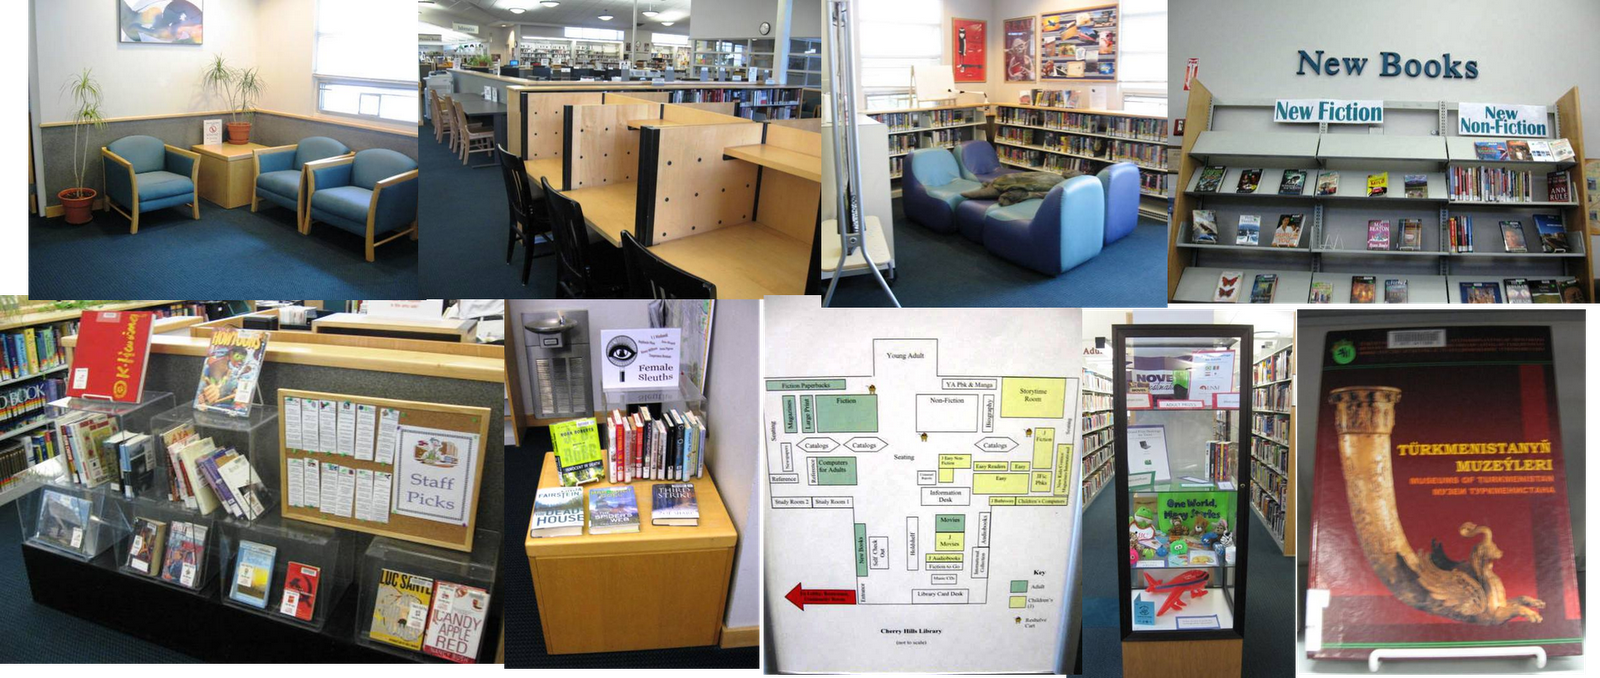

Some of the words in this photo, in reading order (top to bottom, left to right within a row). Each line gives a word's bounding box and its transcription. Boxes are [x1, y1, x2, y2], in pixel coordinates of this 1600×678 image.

[1297, 50, 1368, 76] New
[1379, 52, 1479, 79] Books
[1275, 101, 1314, 121] New
[1318, 101, 1382, 122] Fiction
[1484, 106, 1518, 120] New
[1460, 118, 1547, 136] Non-Fiction
[1549, 193, 1568, 201] RULE
[639, 363, 674, 372] Female
[638, 373, 674, 382] Sleuths
[10, 383, 45, 406] BOOK
[1020, 388, 1048, 396] Storytime
[986, 400, 994, 428] Biography
[1456, 457, 1554, 472] MUZEÝLERI
[411, 473, 455, 491] Staff
[1409, 477, 1460, 485] MUSEUMS
[1477, 476, 1554, 484] TURKMENISTAN
[407, 491, 455, 510] Picks
[1166, 498, 1186, 508] One
[1186, 498, 1218, 508] World,
[537, 514, 584, 526] HOUSE
[1164, 510, 1188, 521] Many
[379, 569, 399, 587] LUC
[434, 608, 483, 631] CANDY
[438, 622, 471, 643] APPLE
[435, 635, 468, 654] RED
